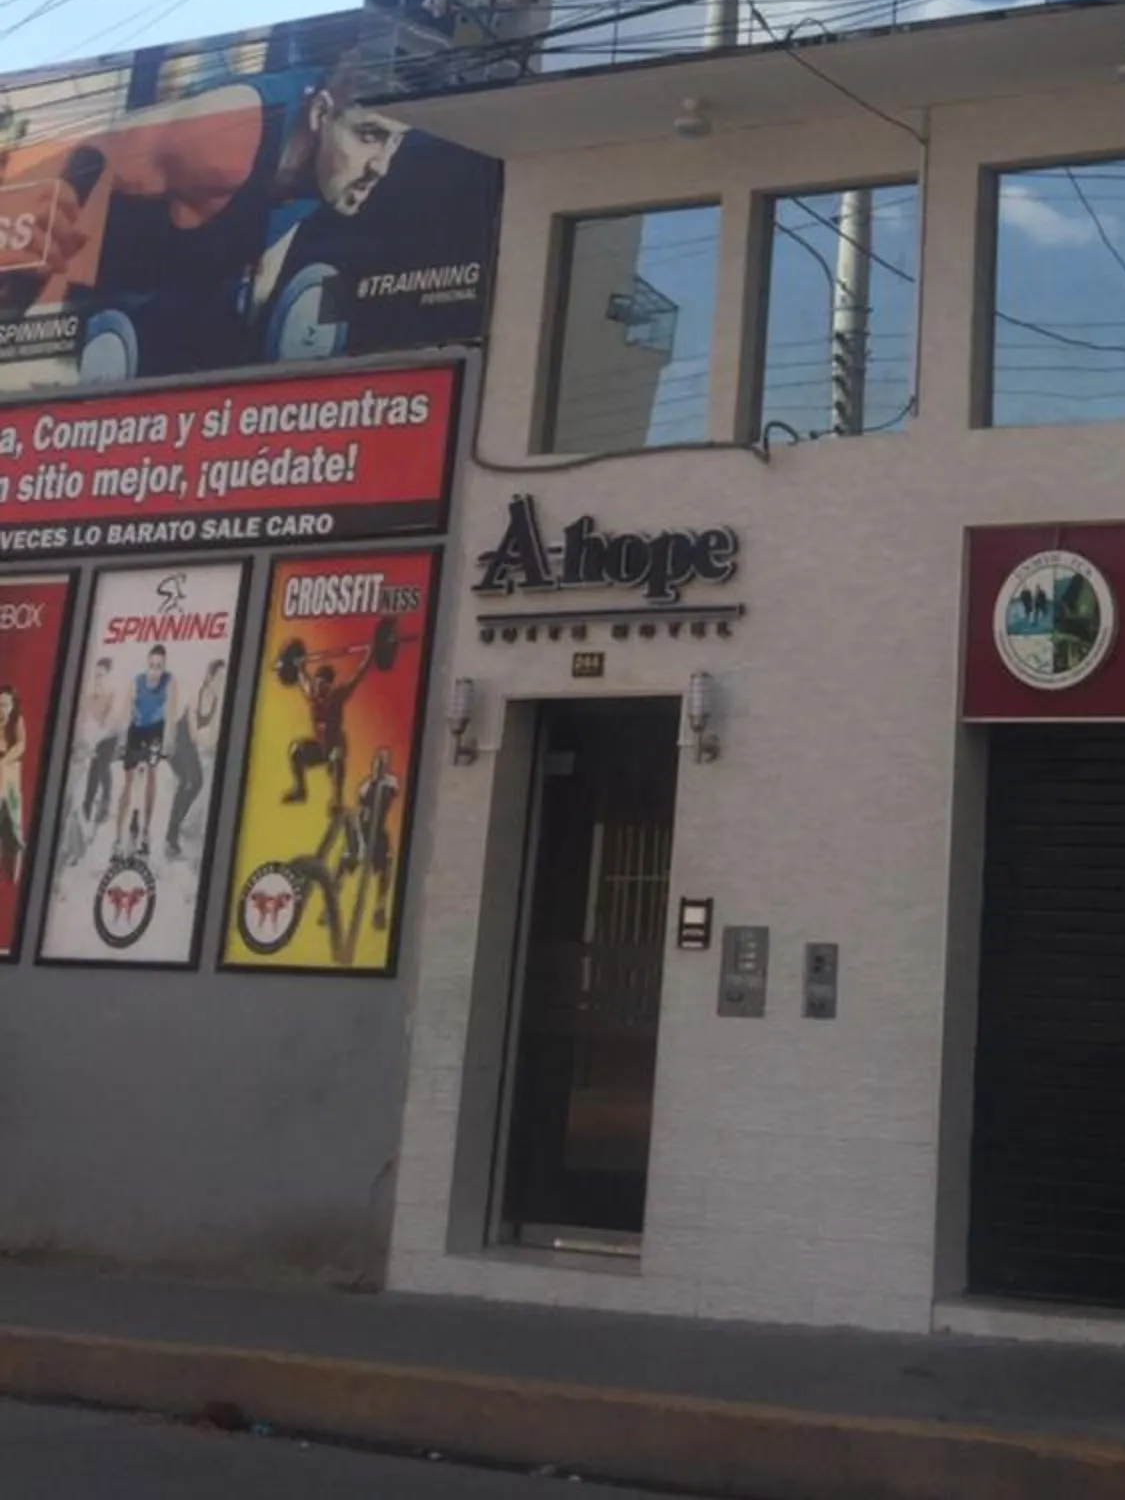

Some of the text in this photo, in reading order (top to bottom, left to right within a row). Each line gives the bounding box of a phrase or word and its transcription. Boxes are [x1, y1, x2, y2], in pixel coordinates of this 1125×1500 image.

[357, 262, 480, 299] #TRAINNING
[33, 412, 168, 453] Compara
[174, 413, 193, 448] y
[203, 401, 231, 438] si
[239, 390, 428, 434] encuentras
[16, 463, 83, 501] sitio
[92, 462, 188, 502] mejor,
[0, 513, 335, 550] VECES LO BARATO SALE CARO
[103, 611, 229, 645] SPINNING
